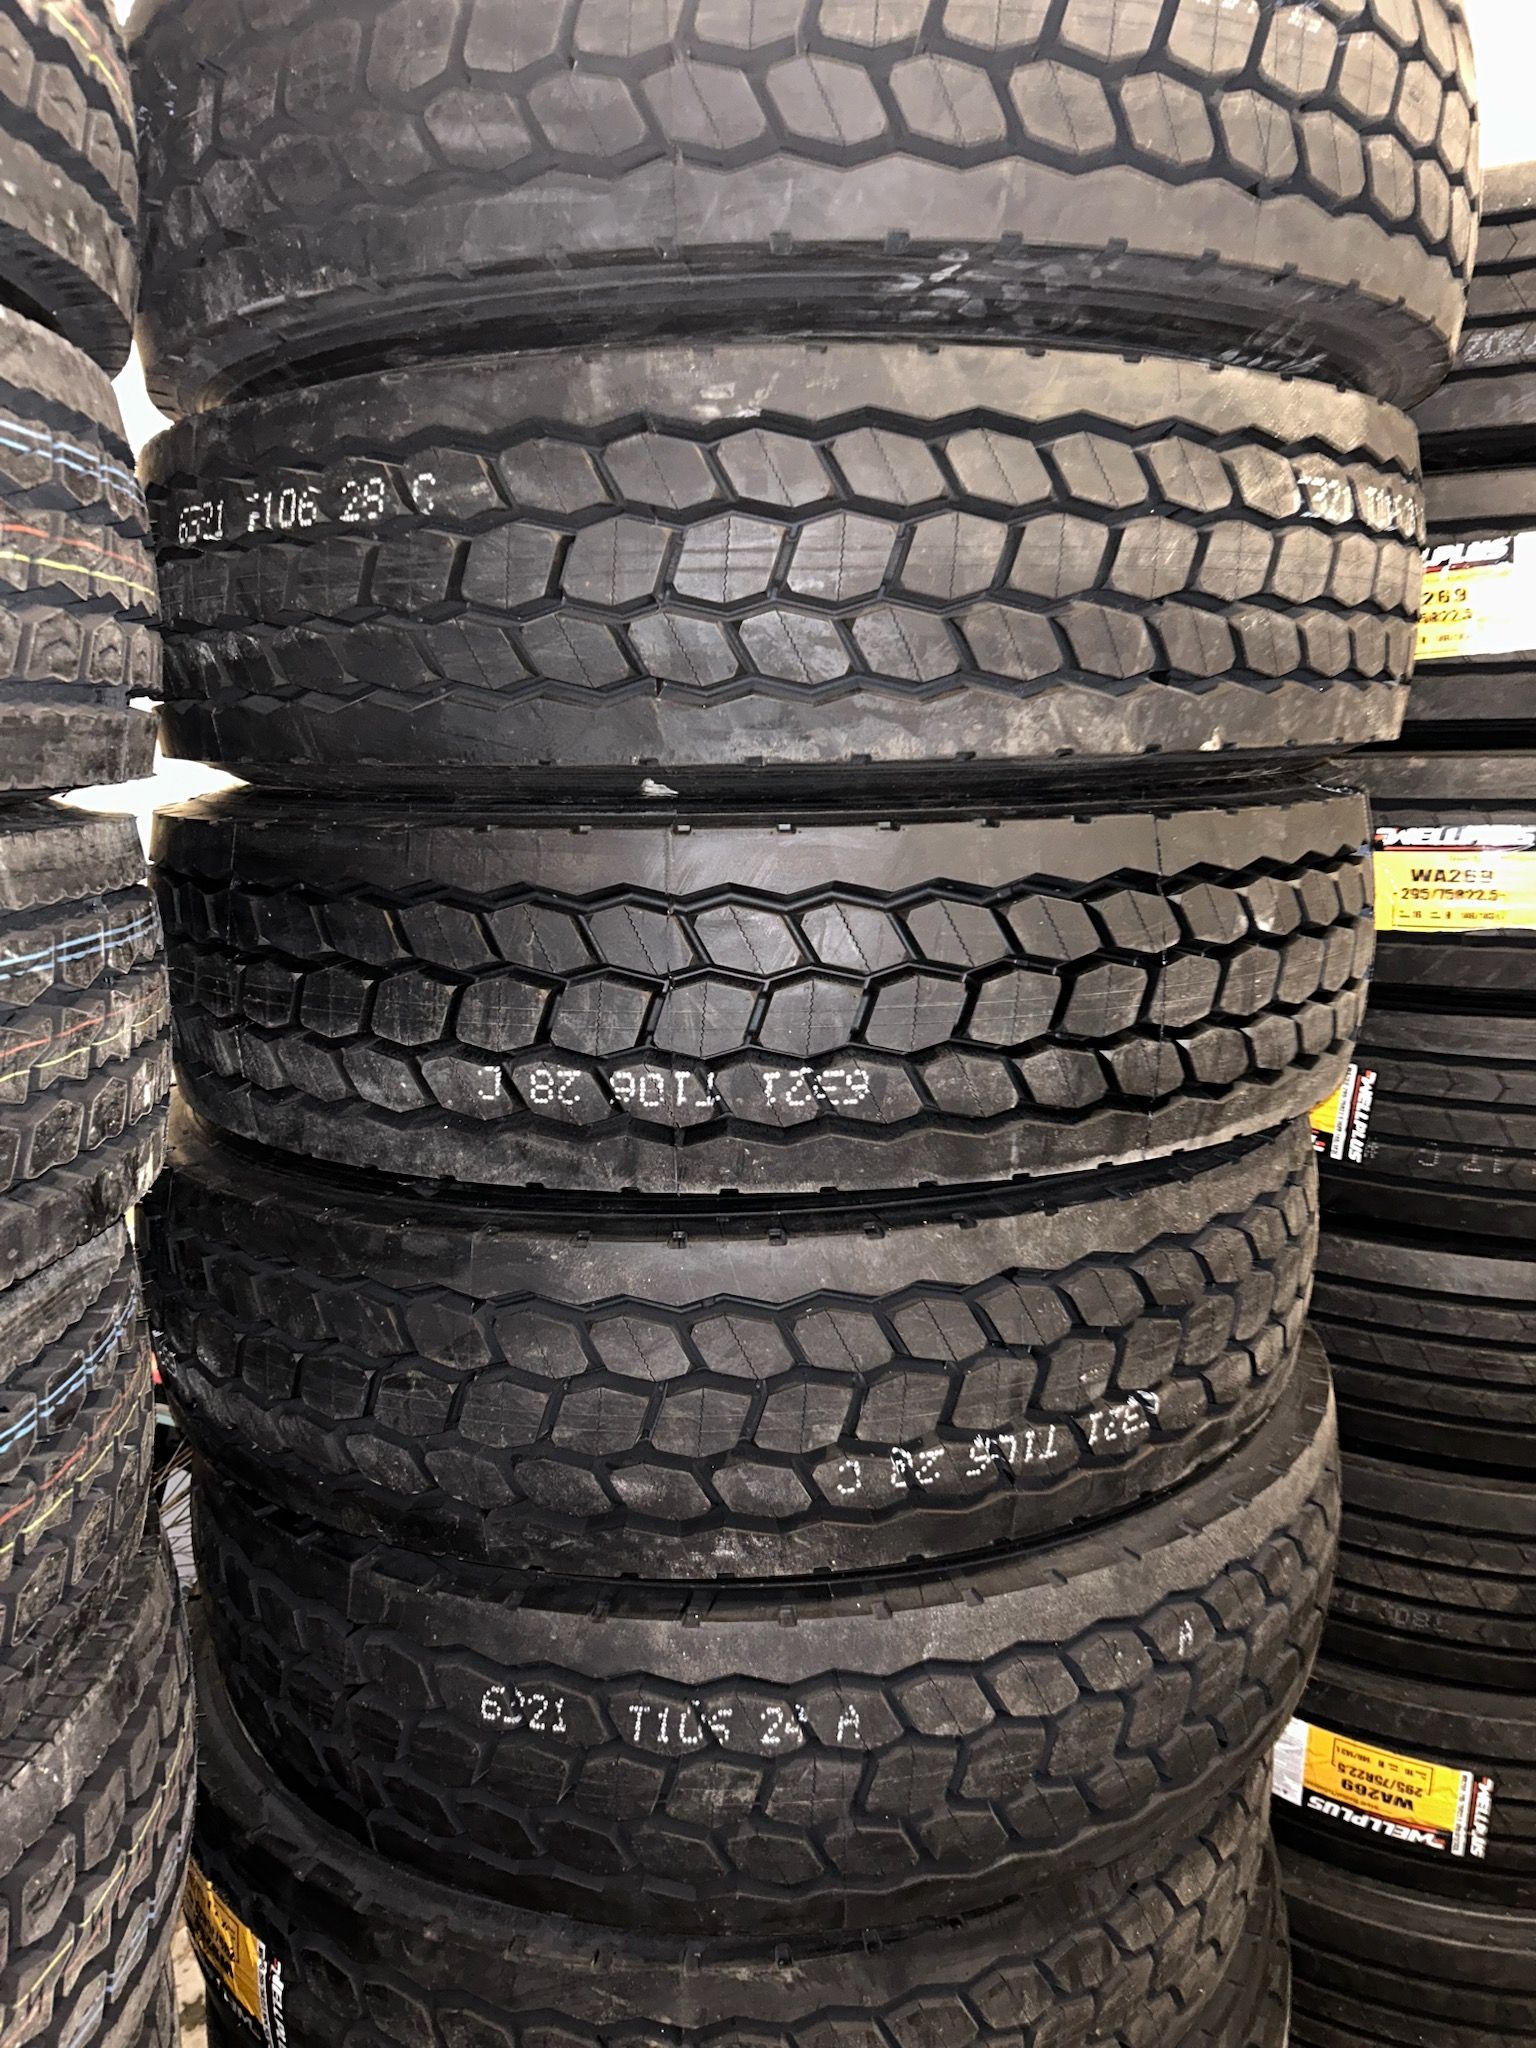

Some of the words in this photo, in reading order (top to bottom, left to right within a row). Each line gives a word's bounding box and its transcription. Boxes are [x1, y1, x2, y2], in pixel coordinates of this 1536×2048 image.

[1348, 1069, 1377, 1164] WELLPLUS
[1337, 1763, 1424, 1797] 295/75R22.5
[1342, 1777, 1415, 1811] WA269
[1307, 1795, 1440, 1849] WELLPLUS
